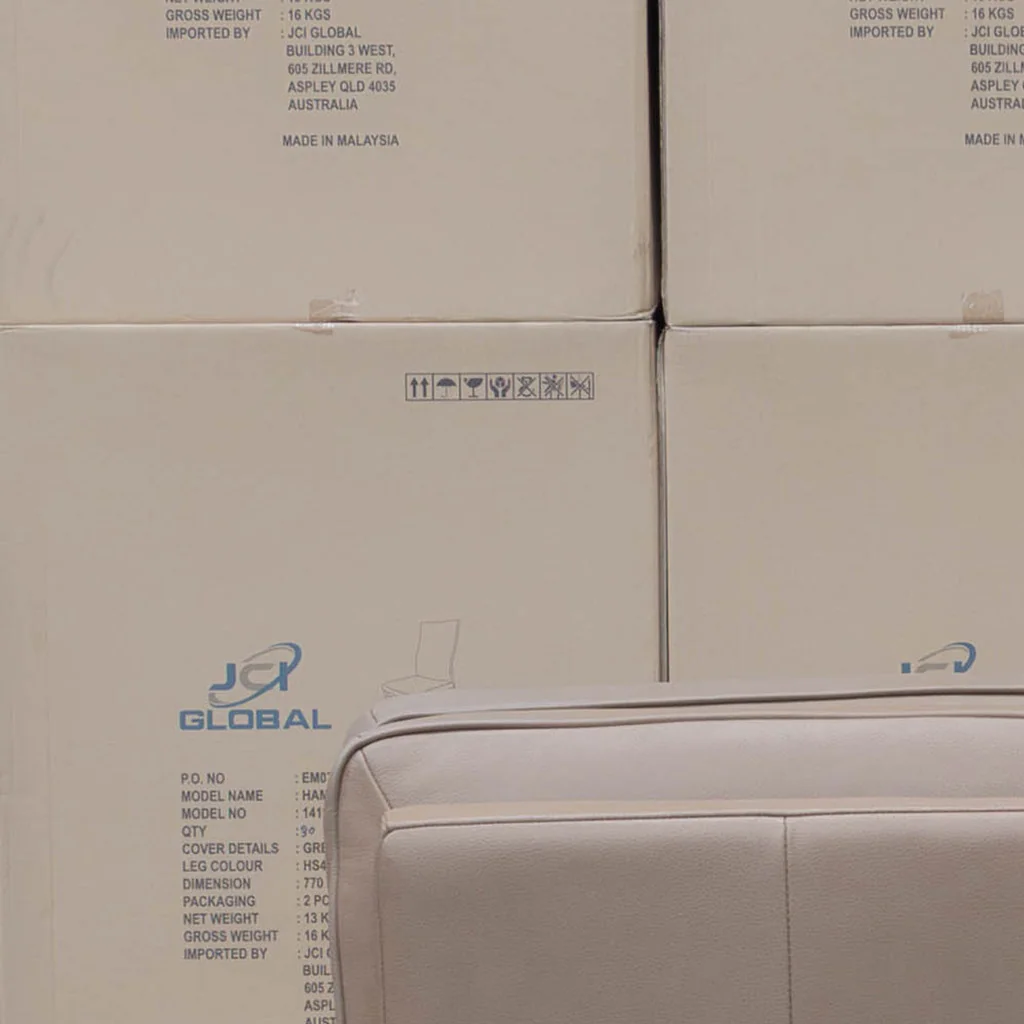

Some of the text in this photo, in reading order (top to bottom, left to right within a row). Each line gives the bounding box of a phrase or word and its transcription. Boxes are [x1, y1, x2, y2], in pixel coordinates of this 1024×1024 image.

[166, 9, 209, 21] GROSS
[213, 9, 261, 21] WEIGHT
[288, 9, 301, 21] 16
[305, 9, 331, 21] KGS
[850, 8, 893, 20] GROSS
[897, 8, 945, 20] WEIGHT
[972, 8, 985, 20] 16
[989, 8, 1014, 20] KGS
[166, 27, 230, 39] IMPORTED
[234, 27, 250, 39] BY
[288, 27, 306, 39] JCI
[310, 27, 361, 39] GLOBAL
[850, 26, 914, 38] IMPORTED
[918, 26, 934, 38] BY
[971, 26, 990, 38] JCI
[286, 45, 395, 57] BUILDING 3 WEST,
[288, 63, 397, 75] 605 ZILLMERE RD,
[971, 62, 991, 74] 605
[288, 81, 396, 93] ASPLEY QLD 4035
[971, 80, 1018, 92] ASPLEY
[288, 99, 358, 110] AUSTRALIA
[283, 135, 399, 146] MADE IN MALAYSIA
[965, 133, 999, 145] MADE
[1004, 133, 1015, 145] IN
[179, 708, 332, 731] GLOBAL
[181, 773, 203, 785] P.O.
[207, 773, 225, 785] NO
[181, 790, 225, 802] MODEL
[228, 790, 263, 802] NAME
[182, 808, 225, 820] MODEL
[228, 808, 246, 820] NO
[303, 806, 321, 819] 141
[182, 826, 206, 838] QTY
[182, 843, 226, 855] COVER
[229, 843, 279, 855] DETAILS
[183, 860, 207, 872] LEG
[210, 860, 262, 872] COLOUR
[183, 878, 250, 890] DIMENSION
[304, 878, 323, 889] 770
[183, 896, 255, 907] PACKAGING
[304, 895, 311, 906] 2
[314, 895, 329, 906] PC
[183, 913, 207, 924] NET
[211, 913, 258, 924] WEIGHT
[304, 912, 318, 924] 13
[184, 930, 226, 942] GROSS
[231, 930, 279, 942] WEIGHT
[305, 930, 318, 942] 16
[184, 948, 247, 960] IMPORTED
[251, 948, 267, 960] BY
[304, 948, 323, 959] JCI
[303, 965, 330, 976] BUIL
[304, 982, 325, 993] 605
[304, 1000, 335, 1011] ASPL
